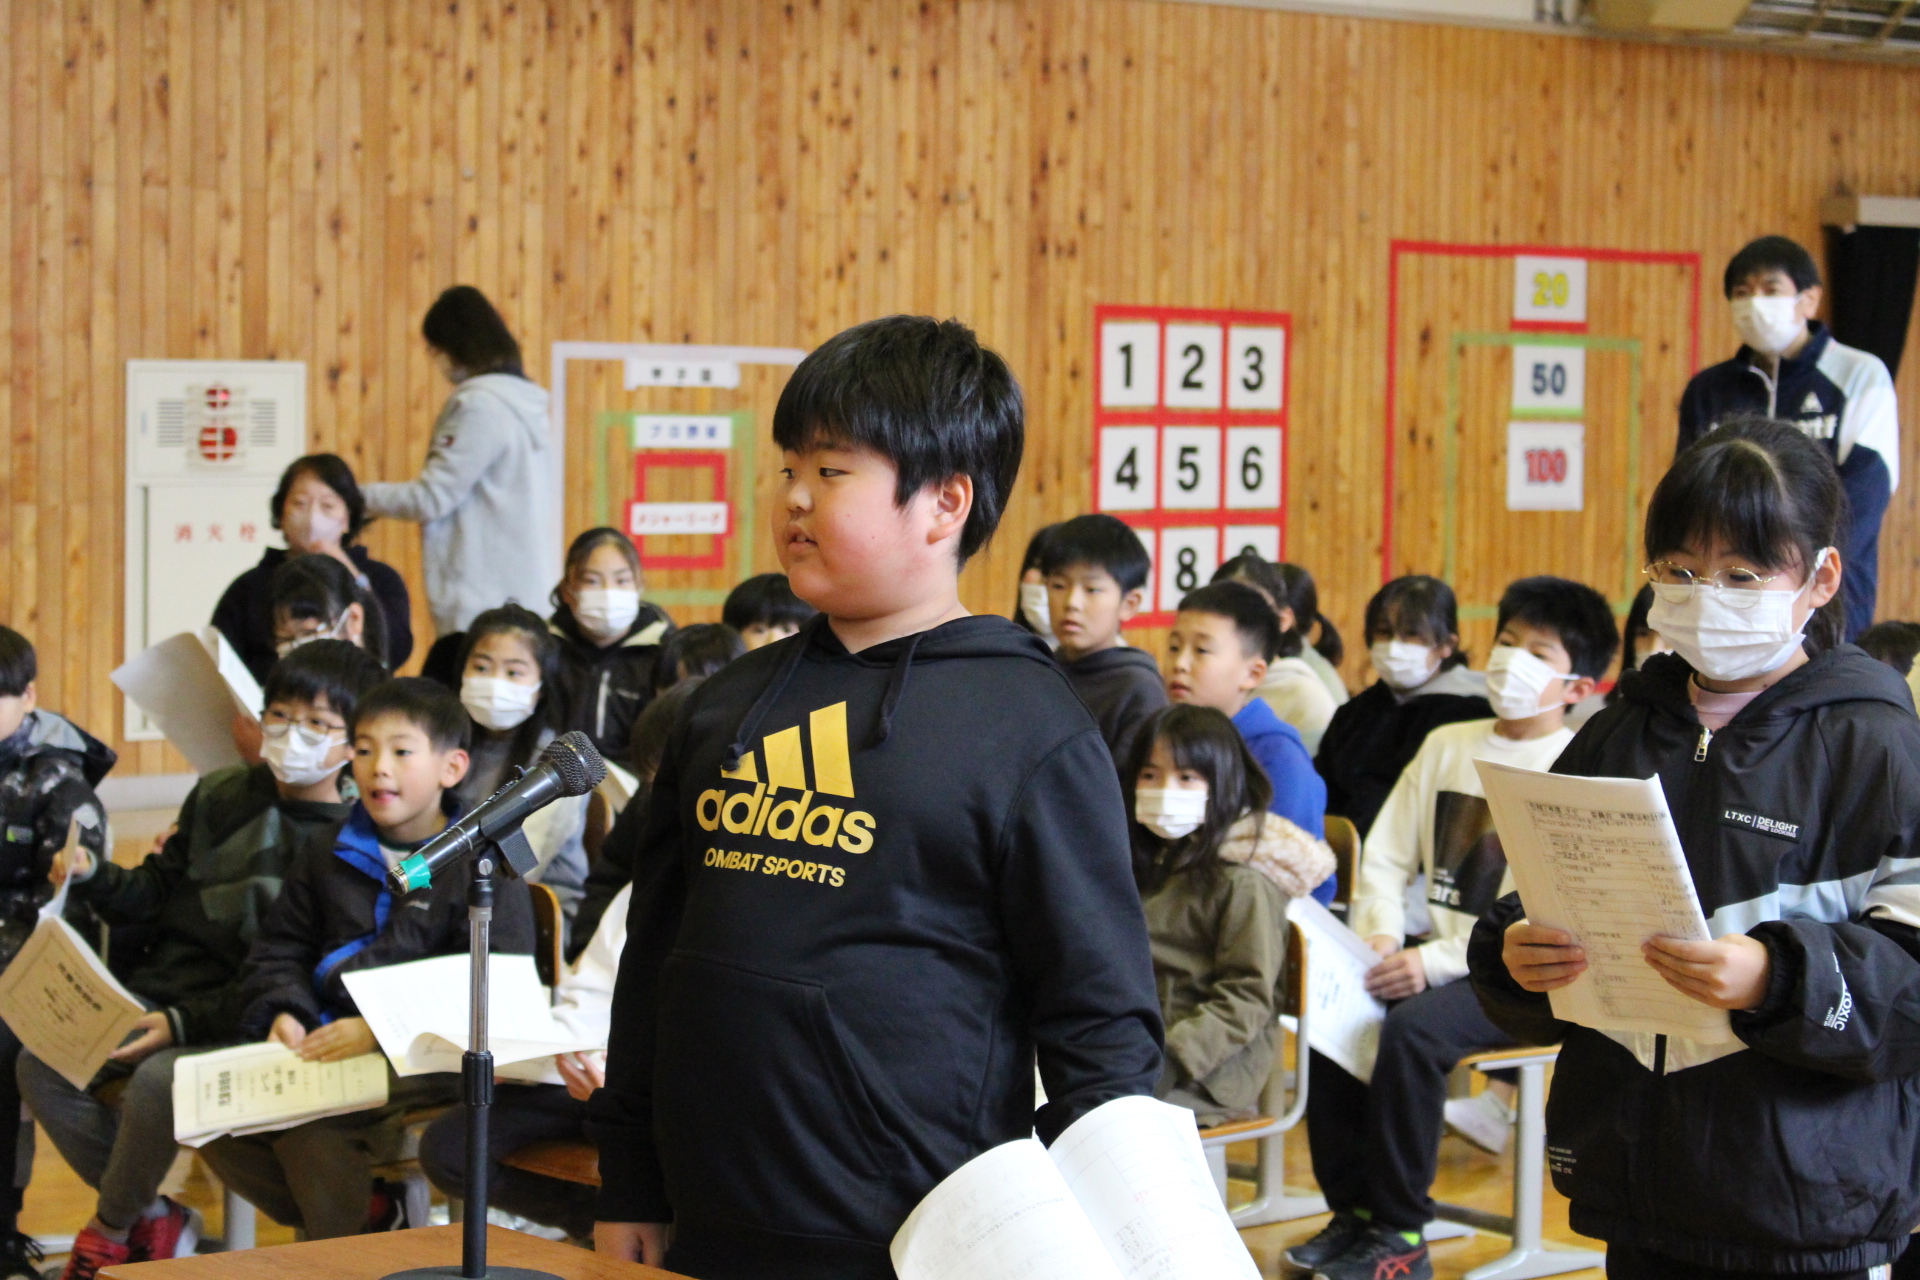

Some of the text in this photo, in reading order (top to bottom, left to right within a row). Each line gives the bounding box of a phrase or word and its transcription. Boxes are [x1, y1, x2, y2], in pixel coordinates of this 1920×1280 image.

[1532, 272, 1570, 306] 20
[1119, 342, 1264, 391] 1 2 3
[1531, 363, 1566, 395] 50
[1115, 446, 1263, 491] 4 5 6
[1525, 449, 1568, 484] 100
[174, 521, 257, 543] 消火栓
[1176, 547, 1197, 592] 8
[696, 782, 876, 854] adidas
[1724, 810, 1752, 824] LTXC
[1757, 816, 1799, 833] DELIGHT
[704, 848, 846, 888] OMBAT SPORTS
